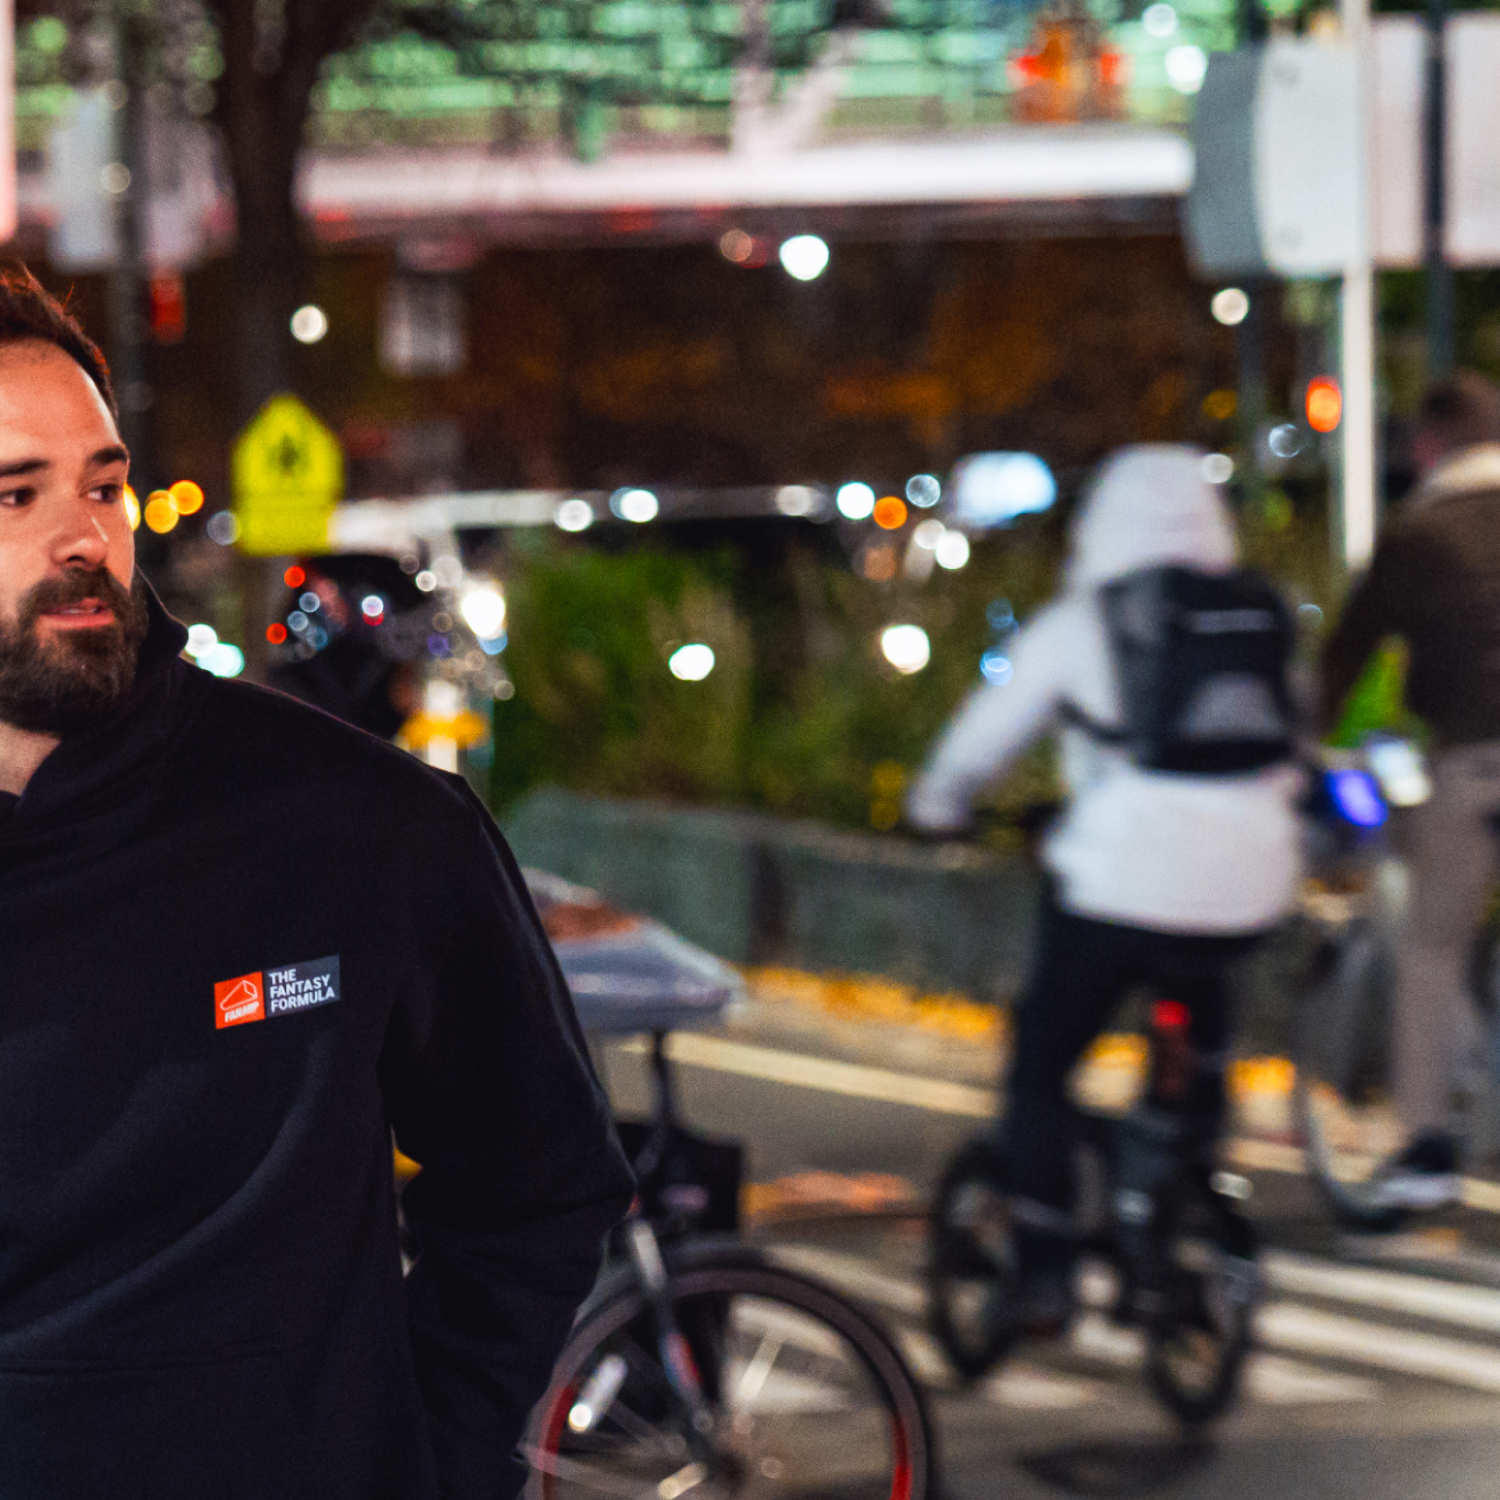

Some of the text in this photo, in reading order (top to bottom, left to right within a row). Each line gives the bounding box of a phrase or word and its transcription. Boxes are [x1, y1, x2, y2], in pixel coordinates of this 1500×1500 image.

[269, 968, 296, 985] THE
[270, 973, 331, 998] FANTASY
[271, 986, 335, 1013] FORMULA
[225, 1001, 260, 1023] FANAMP
